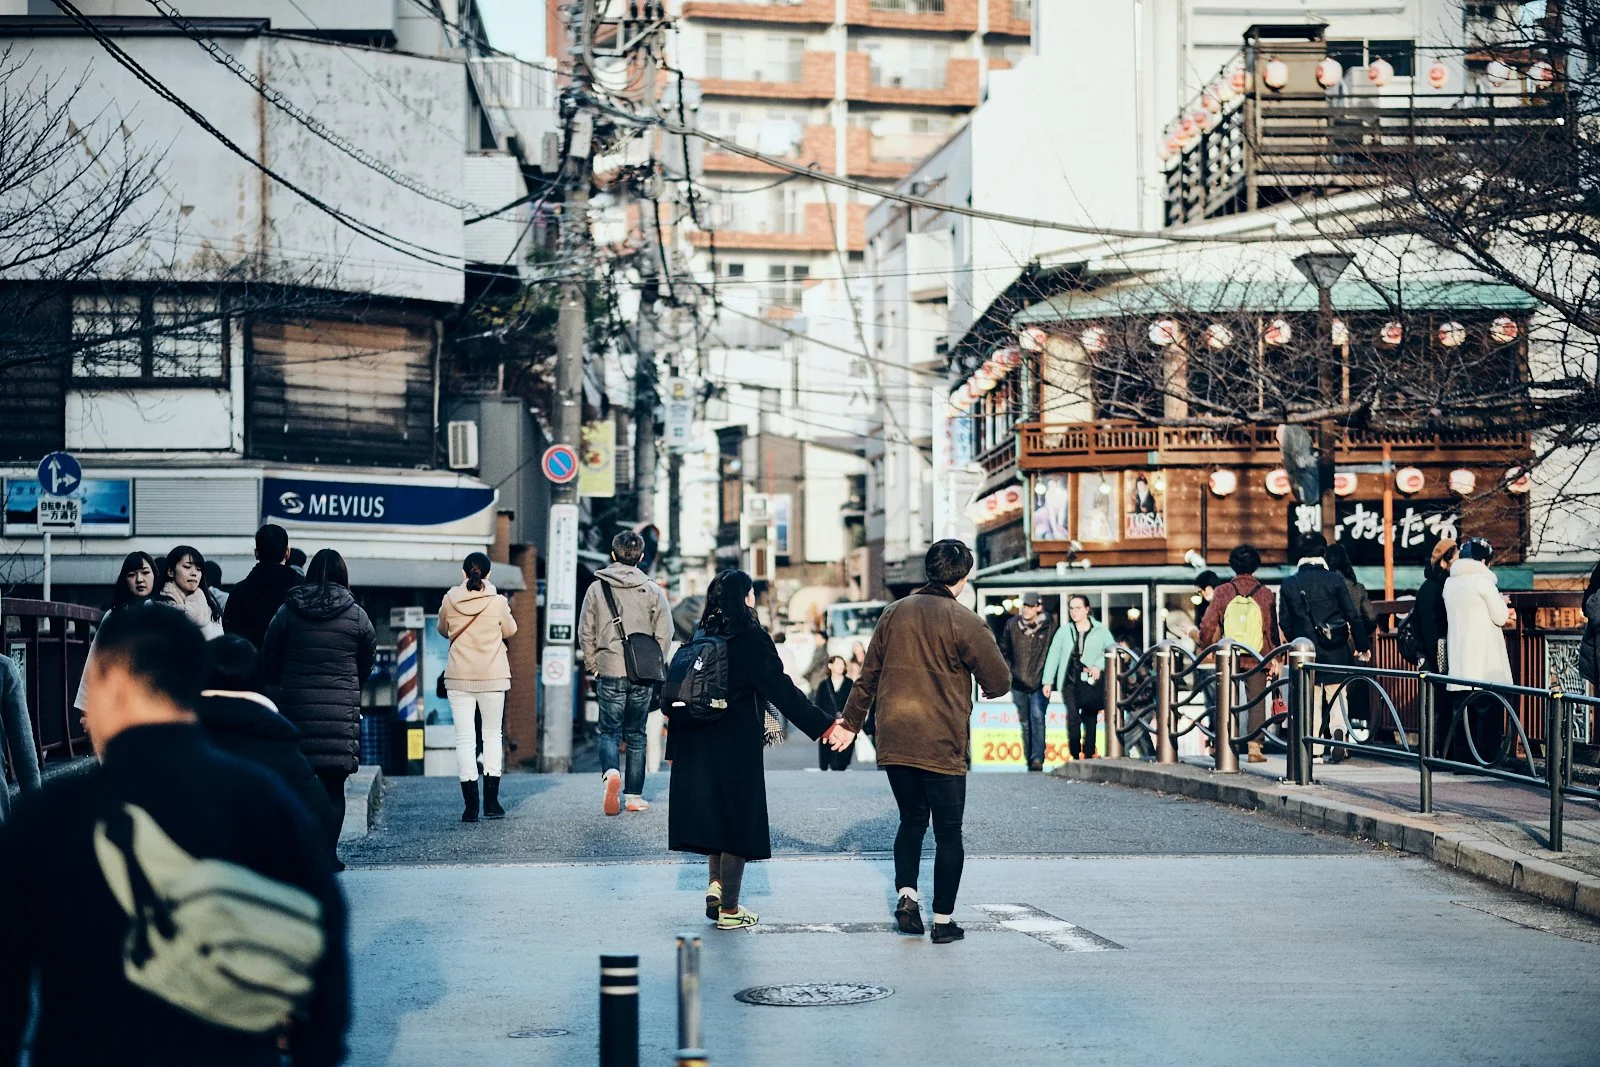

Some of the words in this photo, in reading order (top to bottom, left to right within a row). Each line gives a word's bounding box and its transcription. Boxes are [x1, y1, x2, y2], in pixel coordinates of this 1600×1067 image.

[308, 493, 384, 518] MEVIUS
[41, 509, 78, 520] 一方通行
[1127, 512, 1164, 528] TOSA
[983, 742, 1022, 760] 200
